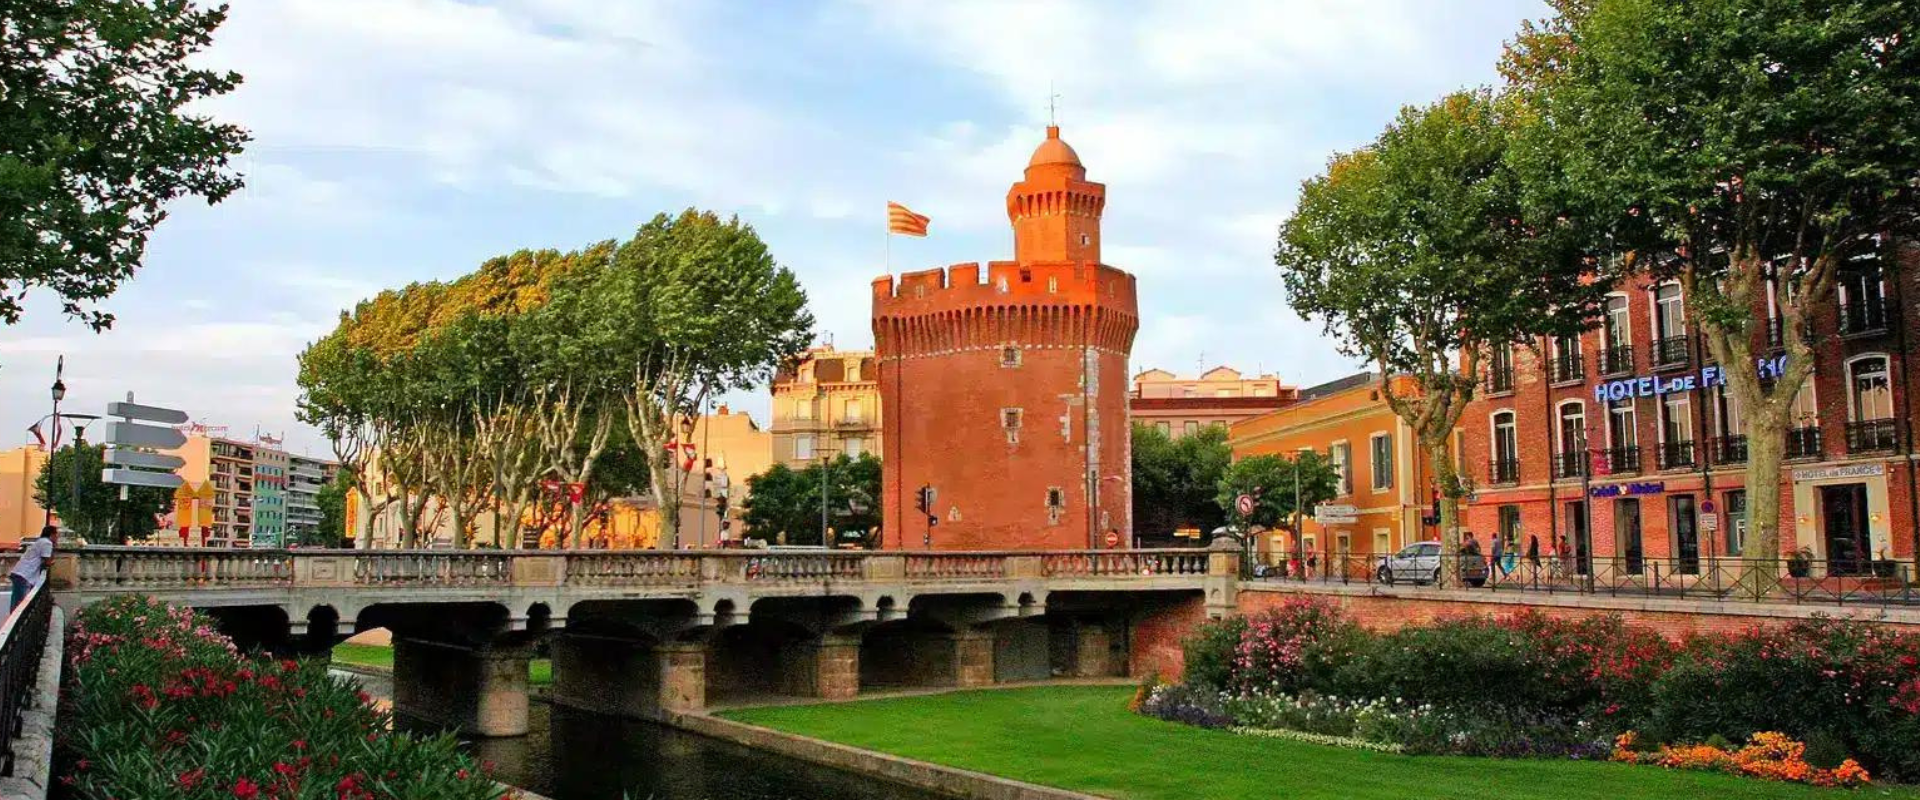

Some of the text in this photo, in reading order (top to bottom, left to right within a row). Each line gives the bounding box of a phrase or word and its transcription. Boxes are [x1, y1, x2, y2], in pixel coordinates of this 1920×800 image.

[1594, 375, 1666, 402] HOTEL
[1672, 376, 1695, 391] DE
[1840, 463, 1876, 476] FRANCE
